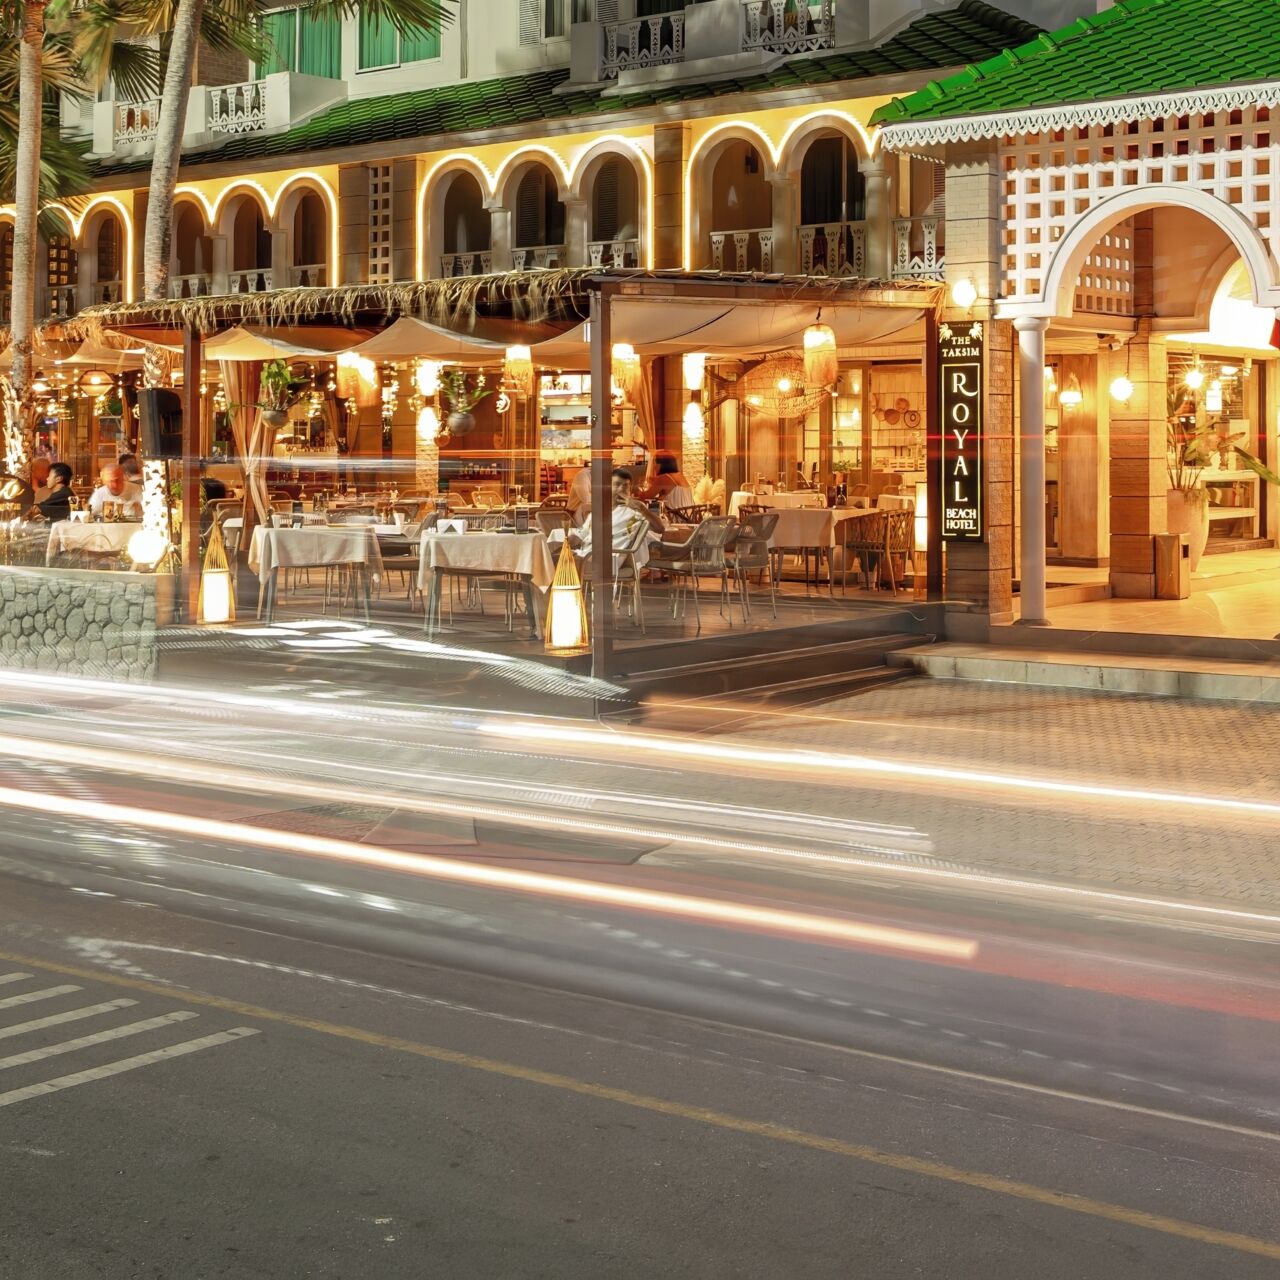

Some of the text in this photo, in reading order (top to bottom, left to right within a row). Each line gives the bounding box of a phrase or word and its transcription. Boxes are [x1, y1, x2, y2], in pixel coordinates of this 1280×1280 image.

[951, 336, 971, 345] THE
[942, 347, 980, 357] TAKSIM
[952, 372, 979, 502] ROYAL
[946, 508, 977, 520] BEACH
[946, 519, 977, 530] HOTEL
